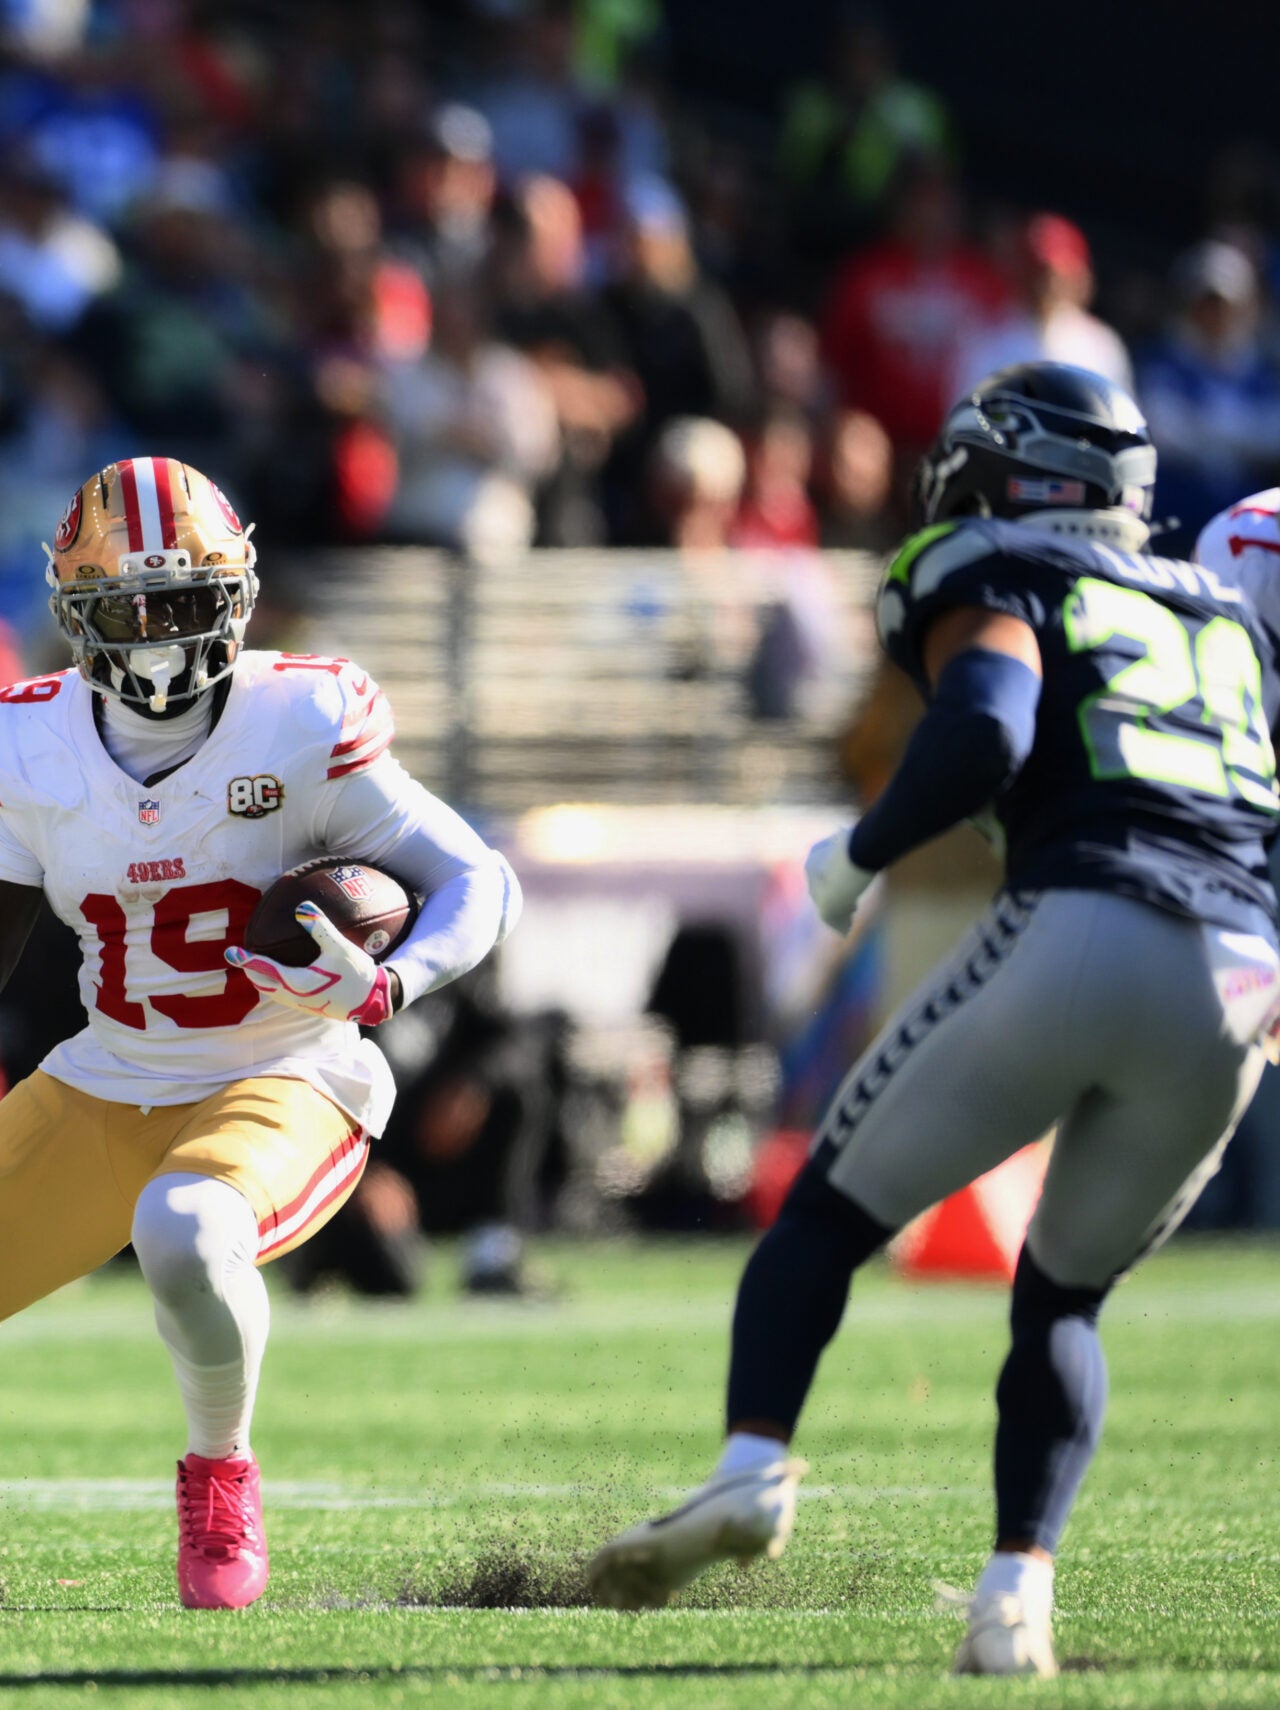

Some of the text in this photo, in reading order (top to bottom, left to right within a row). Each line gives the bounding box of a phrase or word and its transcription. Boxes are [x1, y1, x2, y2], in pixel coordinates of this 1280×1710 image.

[140, 809, 158, 822] NFL
[127, 857, 186, 884] 49ERS
[342, 877, 376, 898] NF
[79, 878, 262, 1031] 19
